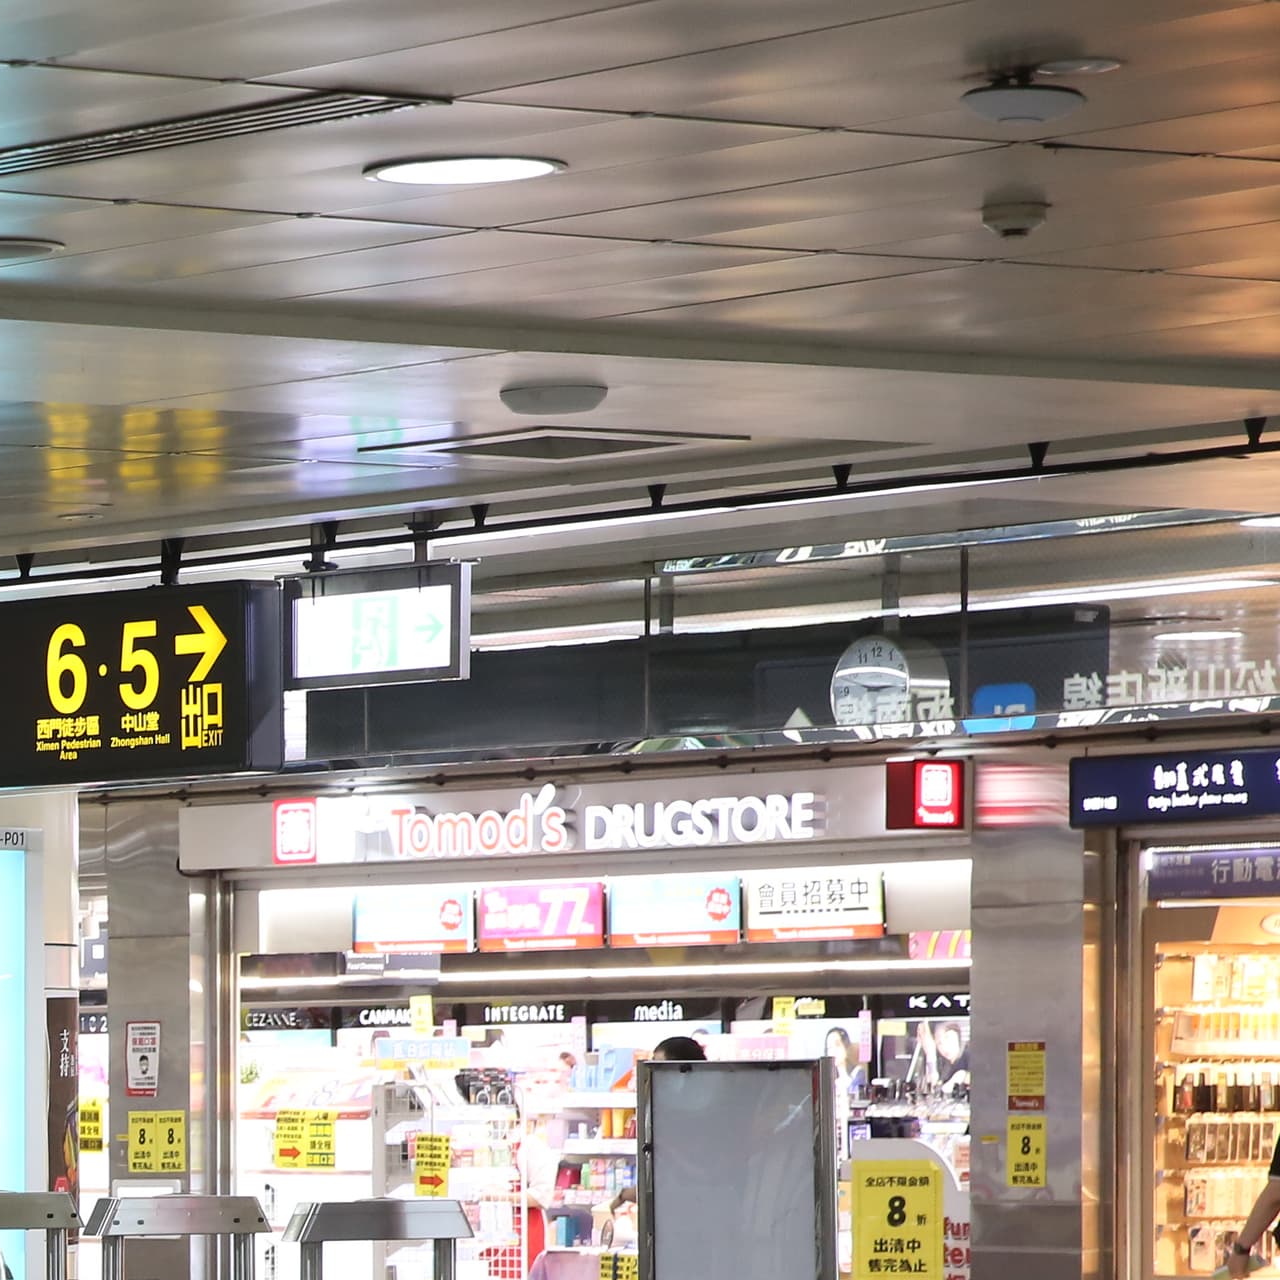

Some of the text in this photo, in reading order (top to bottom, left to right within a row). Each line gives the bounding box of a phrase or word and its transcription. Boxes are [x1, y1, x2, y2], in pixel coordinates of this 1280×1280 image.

[36, 715, 100, 740] 西門徒步區
[121, 712, 160, 733] 中山堂
[36, 738, 102, 752] Ximen Pedestrian
[110, 733, 171, 749] Zhongshan Hall
[203, 730, 224, 747] EXIT
[59, 751, 78, 761] Area
[389, 785, 816, 856] Tomod's DRUGSTORE
[1211, 855, 1280, 883] 行動電
[758, 877, 869, 908] 會員招募中
[634, 1001, 683, 1021] media
[909, 993, 970, 1011] KAT
[359, 1008, 414, 1025] CANMAK
[485, 1004, 565, 1023] INTEGRATE
[59, 1029, 70, 1078] 支持
[138, 1128, 146, 1145] 8
[167, 1128, 175, 1145] 8
[1021, 1136, 1031, 1156] 8
[865, 1176, 930, 1188] 全店不限金額
[887, 1195, 907, 1228] 8
[873, 1237, 922, 1254] 出清中
[868, 1258, 928, 1274] 售完為止
